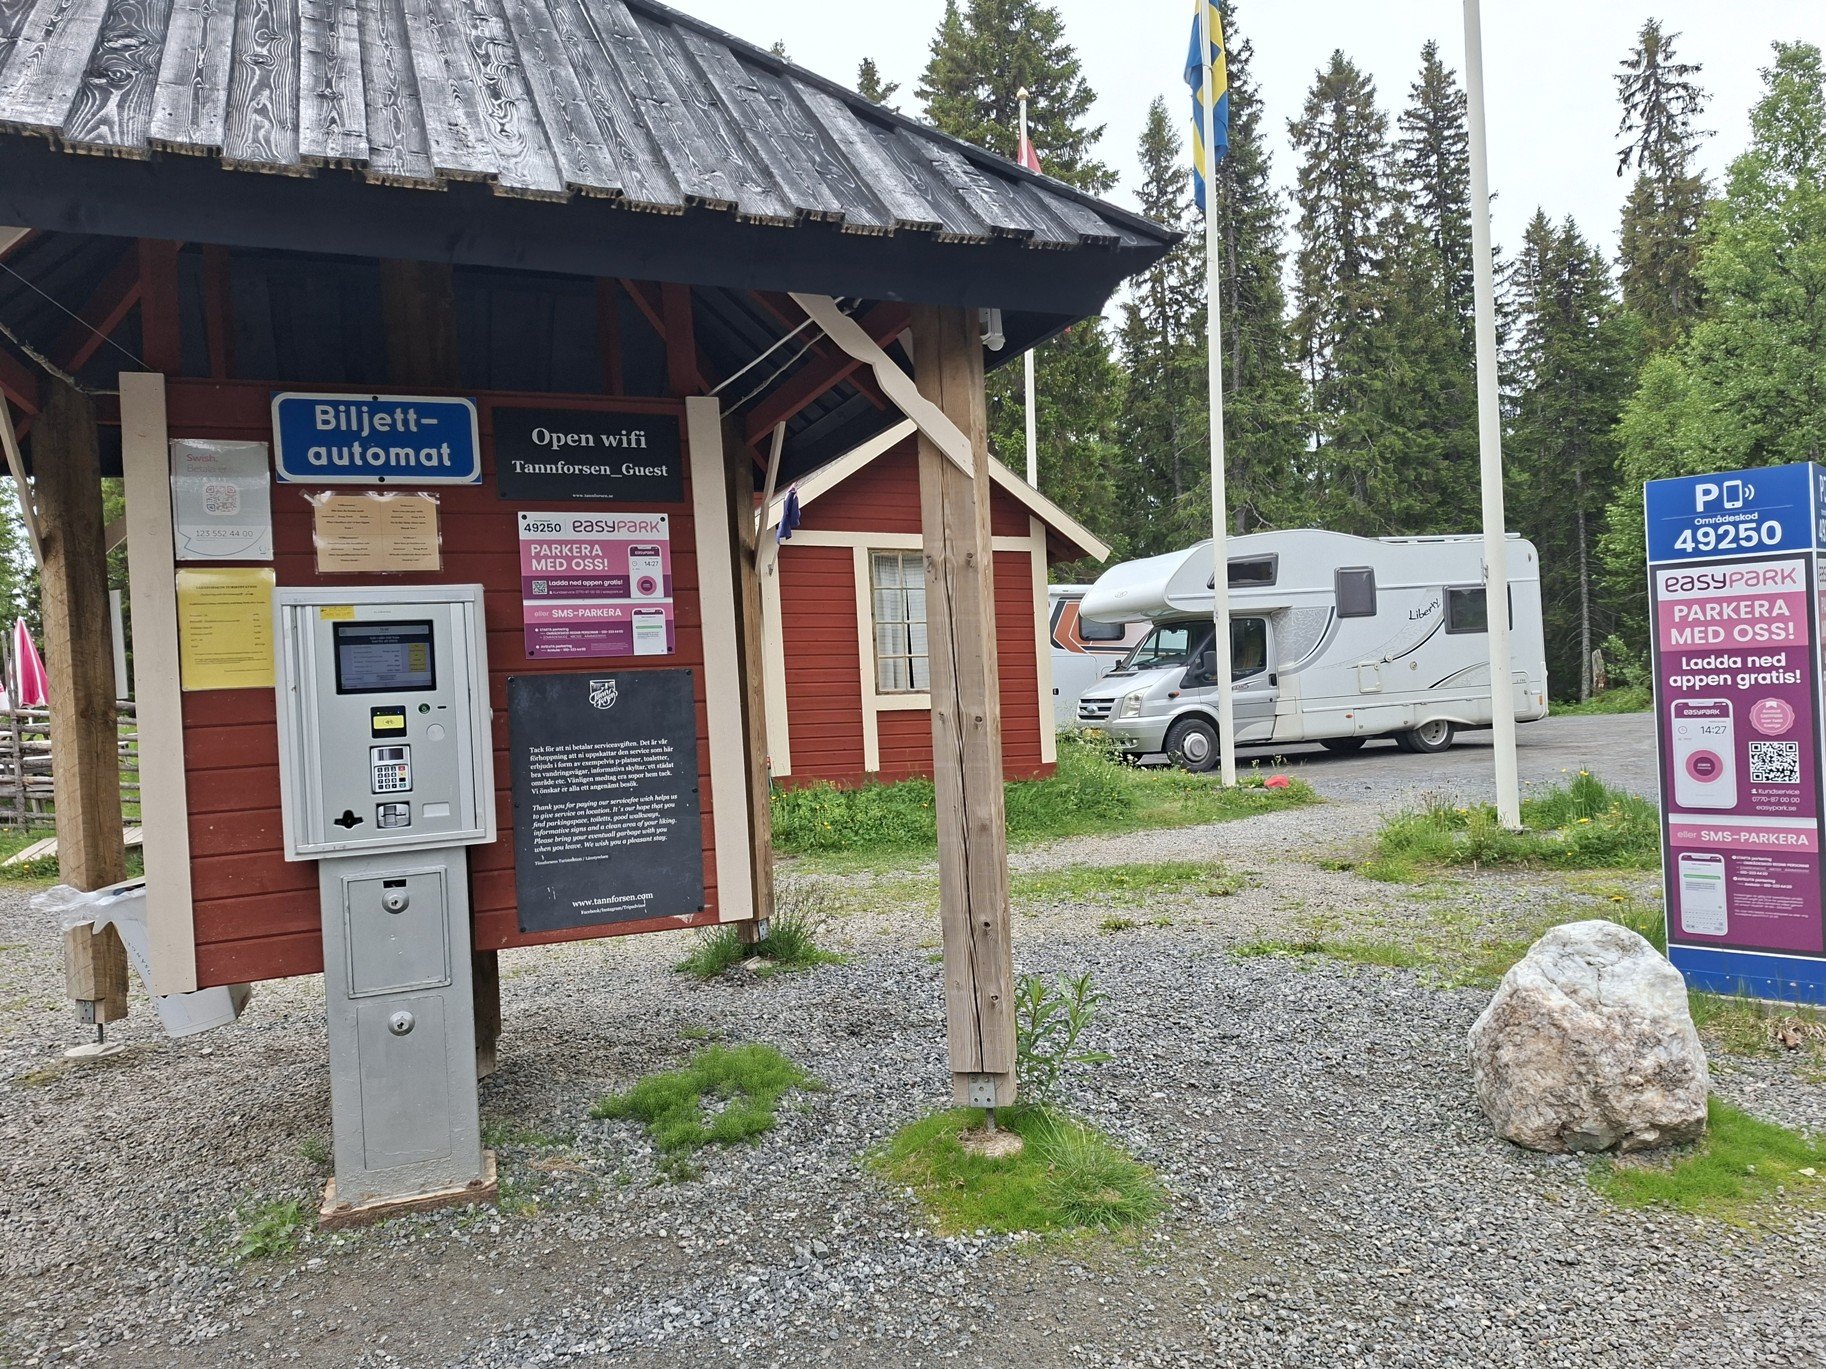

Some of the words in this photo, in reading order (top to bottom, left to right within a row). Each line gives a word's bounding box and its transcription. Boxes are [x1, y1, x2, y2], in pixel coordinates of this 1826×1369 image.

[315, 405, 438, 437] Biljett-
[532, 428, 595, 451] Open
[600, 430, 647, 449] wifi
[308, 442, 451, 466] automat
[512, 460, 668, 478] Tannforsen_Guest
[1695, 483, 1719, 512] P
[1694, 512, 1758, 525] Områdeskod
[196, 530, 210, 538] 123
[212, 530, 227, 538] 552
[524, 523, 561, 533] 49250
[1674, 520, 1782, 553] 49250
[531, 544, 602, 556] PARKERA
[532, 559, 567, 571] MED
[572, 558, 608, 571] OSS!
[603, 579, 623, 587] gratis!
[552, 609, 622, 618] SMS-PARKERA
[1409, 598, 1440, 620] Liberty
[1674, 599, 1790, 622] PARKERA
[1670, 627, 1725, 645] MED
[1733, 622, 1794, 642] OSS!
[1681, 654, 1742, 670] Ladda
[1747, 652, 1786, 668] ned
[1669, 672, 1731, 690] appen
[1736, 669, 1801, 690] gratis!
[594, 740, 638, 751] serviceavgiften.
[529, 753, 567, 763] förhoppning
[585, 750, 616, 759] uppskattar
[530, 761, 553, 770] erbjuds
[615, 756, 643, 765] p-platser,
[643, 754, 670, 762] toaletter,
[542, 767, 588, 778] vandringsvägar,
[590, 765, 624, 773] informativa
[625, 764, 647, 772] skyltar,
[567, 775, 593, 784] Vänligen
[594, 774, 616, 783] medtag
[590, 782, 618, 792] angenämt
[565, 801, 575, 810] for
[576, 800, 597, 809] paying
[610, 796, 638, 806] servicefee
[654, 794, 669, 803] helps
[540, 812, 553, 820] give
[585, 807, 612, 815] location.
[635, 804, 650, 812] hope
[532, 820, 545, 828] find
[546, 817, 590, 828] parkingspace,
[613, 814, 628, 822] good
[533, 826, 569, 836] informative
[570, 825, 586, 834] signs
[658, 817, 676, 826] liking.
[554, 835, 571, 844] bring
[616, 829, 641, 838] garbage
[627, 835, 652, 845] pleasant
[653, 834, 668, 842] stay.
[1701, 831, 1809, 845] SMS-PARKERA
[572, 892, 654, 907] www.tannforsen.com
